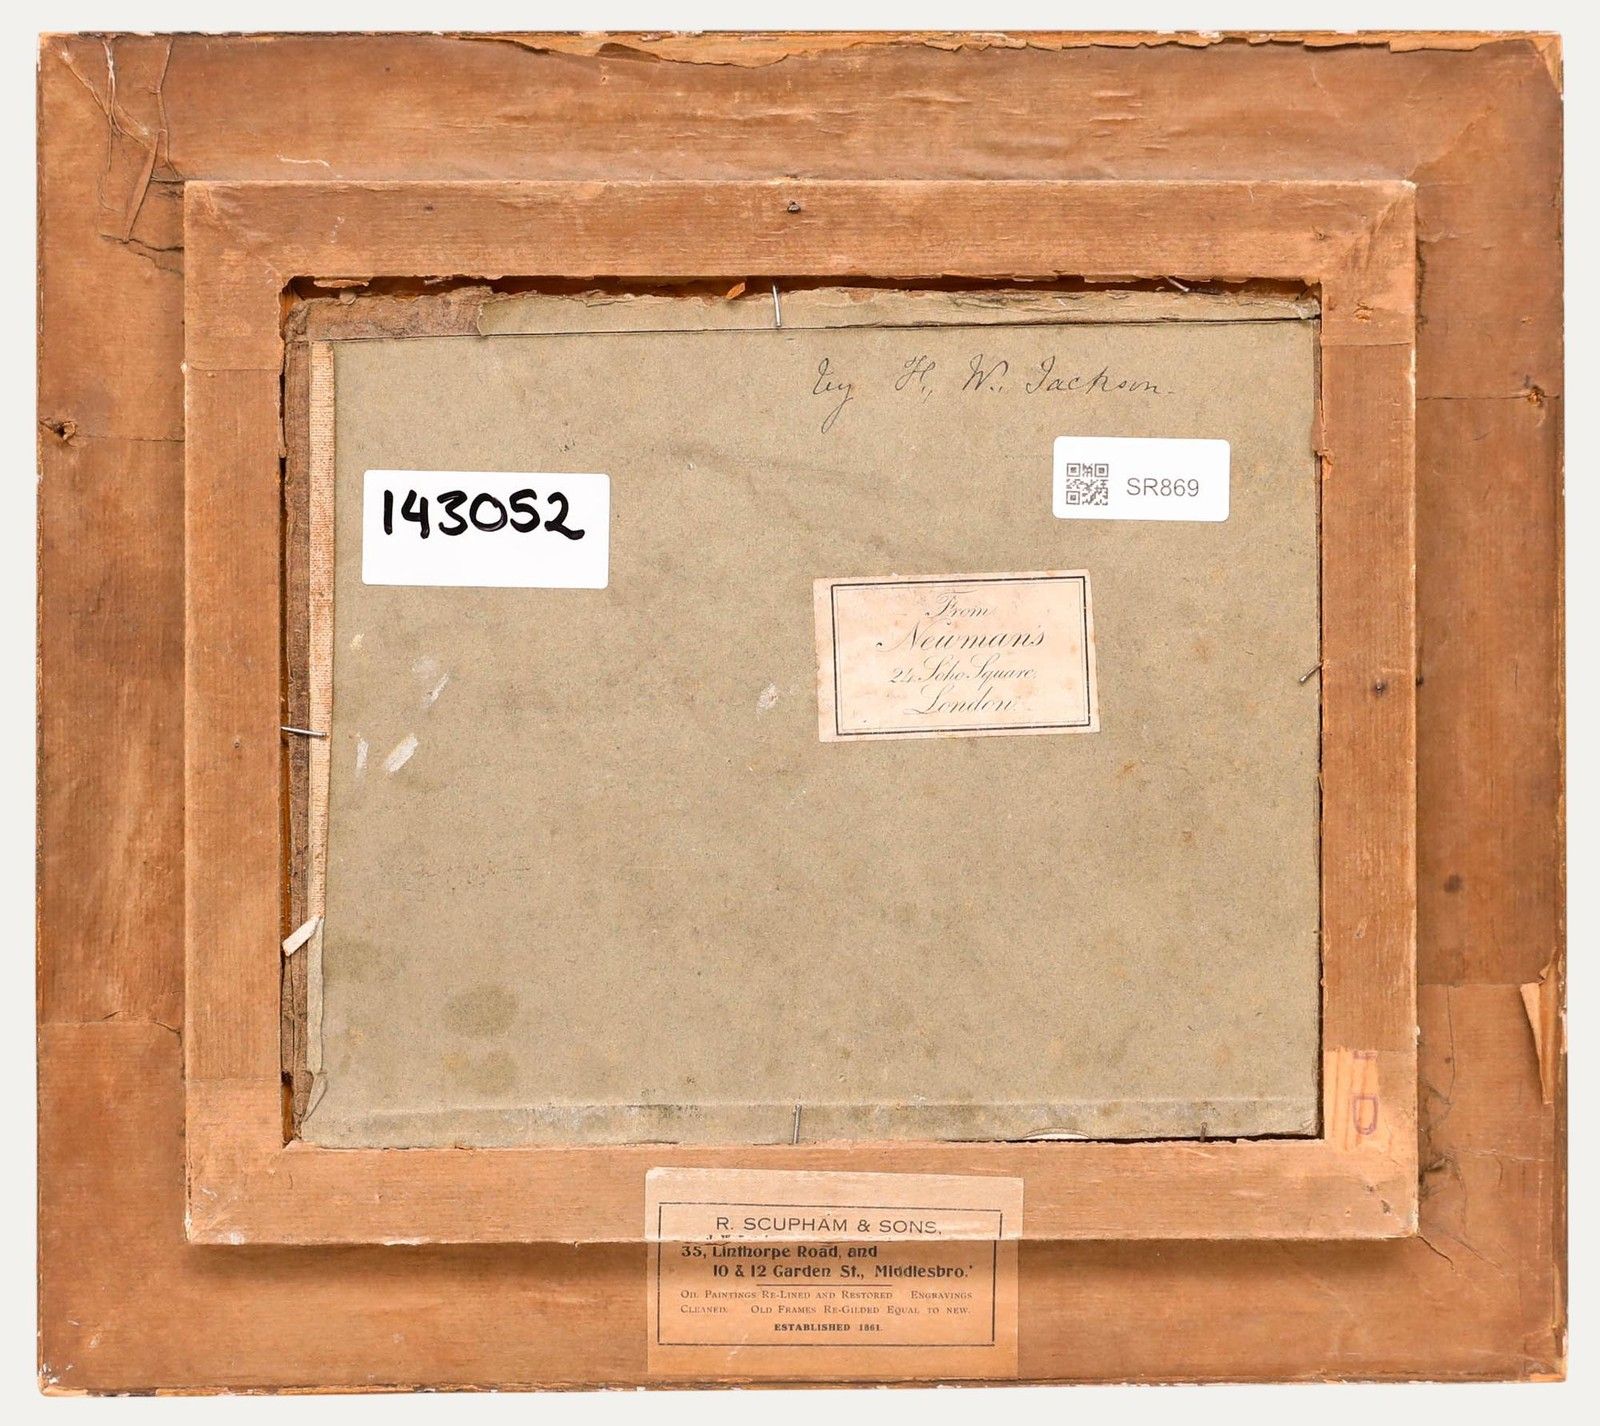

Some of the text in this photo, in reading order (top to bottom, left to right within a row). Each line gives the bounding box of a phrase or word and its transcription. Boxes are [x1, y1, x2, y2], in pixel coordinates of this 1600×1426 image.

[1126, 477, 1200, 498] SR869
[383, 488, 586, 541] 143052
[925, 589, 997, 618] From
[716, 1216, 943, 1236] R. SCUPHAM & SONS,
[681, 1245, 878, 1260] 35, Linthorpe Road, and
[713, 1264, 729, 1277] 10
[735, 1264, 744, 1277] &
[751, 1264, 767, 1277] 12
[773, 1264, 832, 1278] Garden
[774, 1323, 851, 1332] ESTABLISHED
